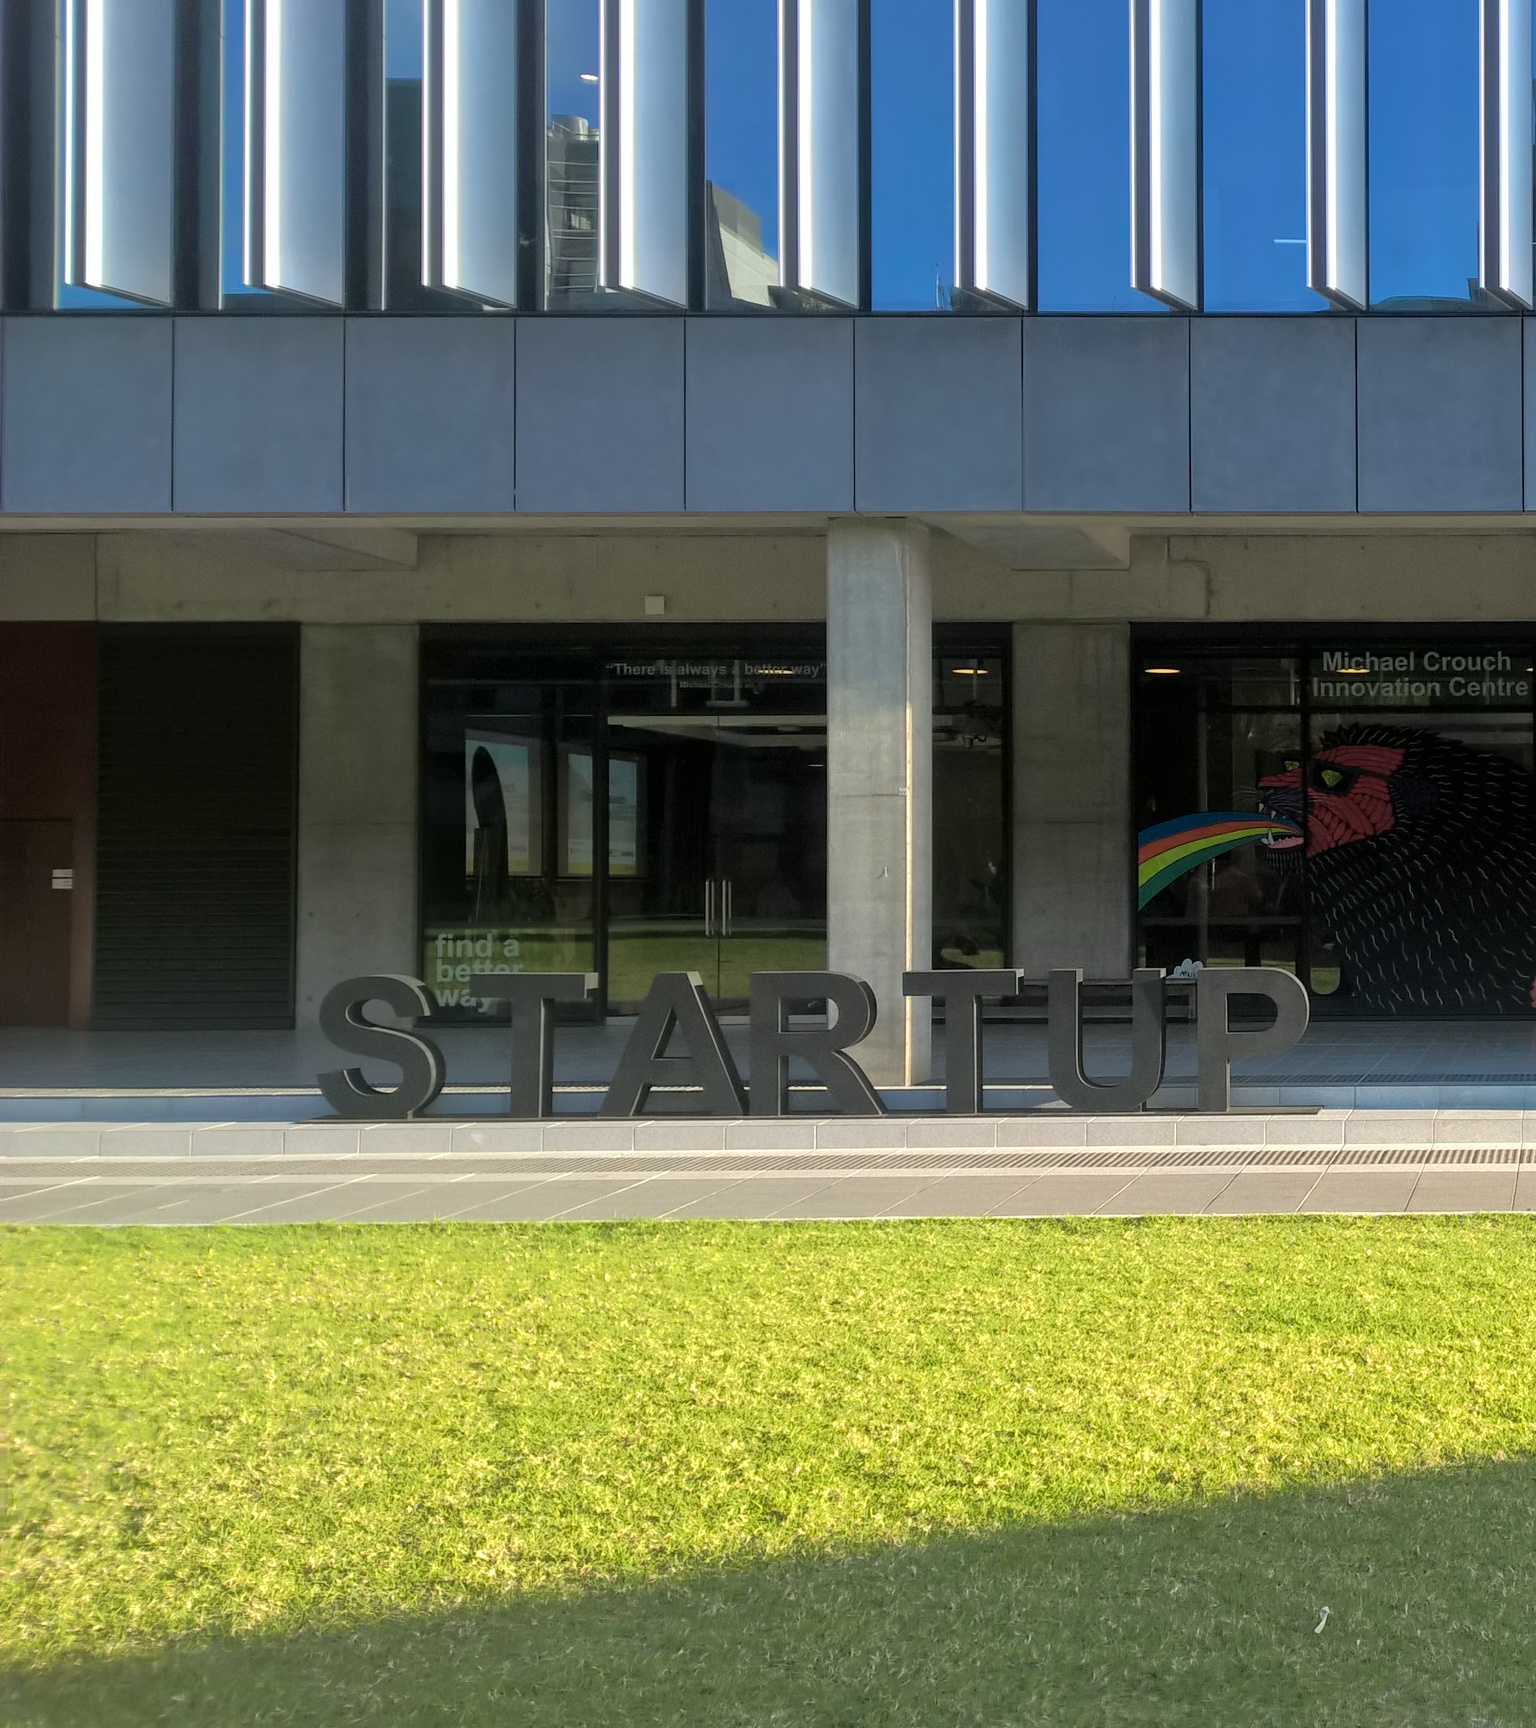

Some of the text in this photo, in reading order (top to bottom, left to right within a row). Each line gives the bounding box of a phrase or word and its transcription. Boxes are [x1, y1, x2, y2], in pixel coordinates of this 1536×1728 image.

[660, 663, 672, 676] is
[677, 663, 727, 678] always
[744, 663, 792, 676] better
[1322, 651, 1511, 671] Michael Crouch
[1312, 677, 1529, 697] Innovation Centre
[435, 934, 520, 957] find a
[435, 989, 492, 1013] way
[317, 967, 1310, 1119] STARTUP
